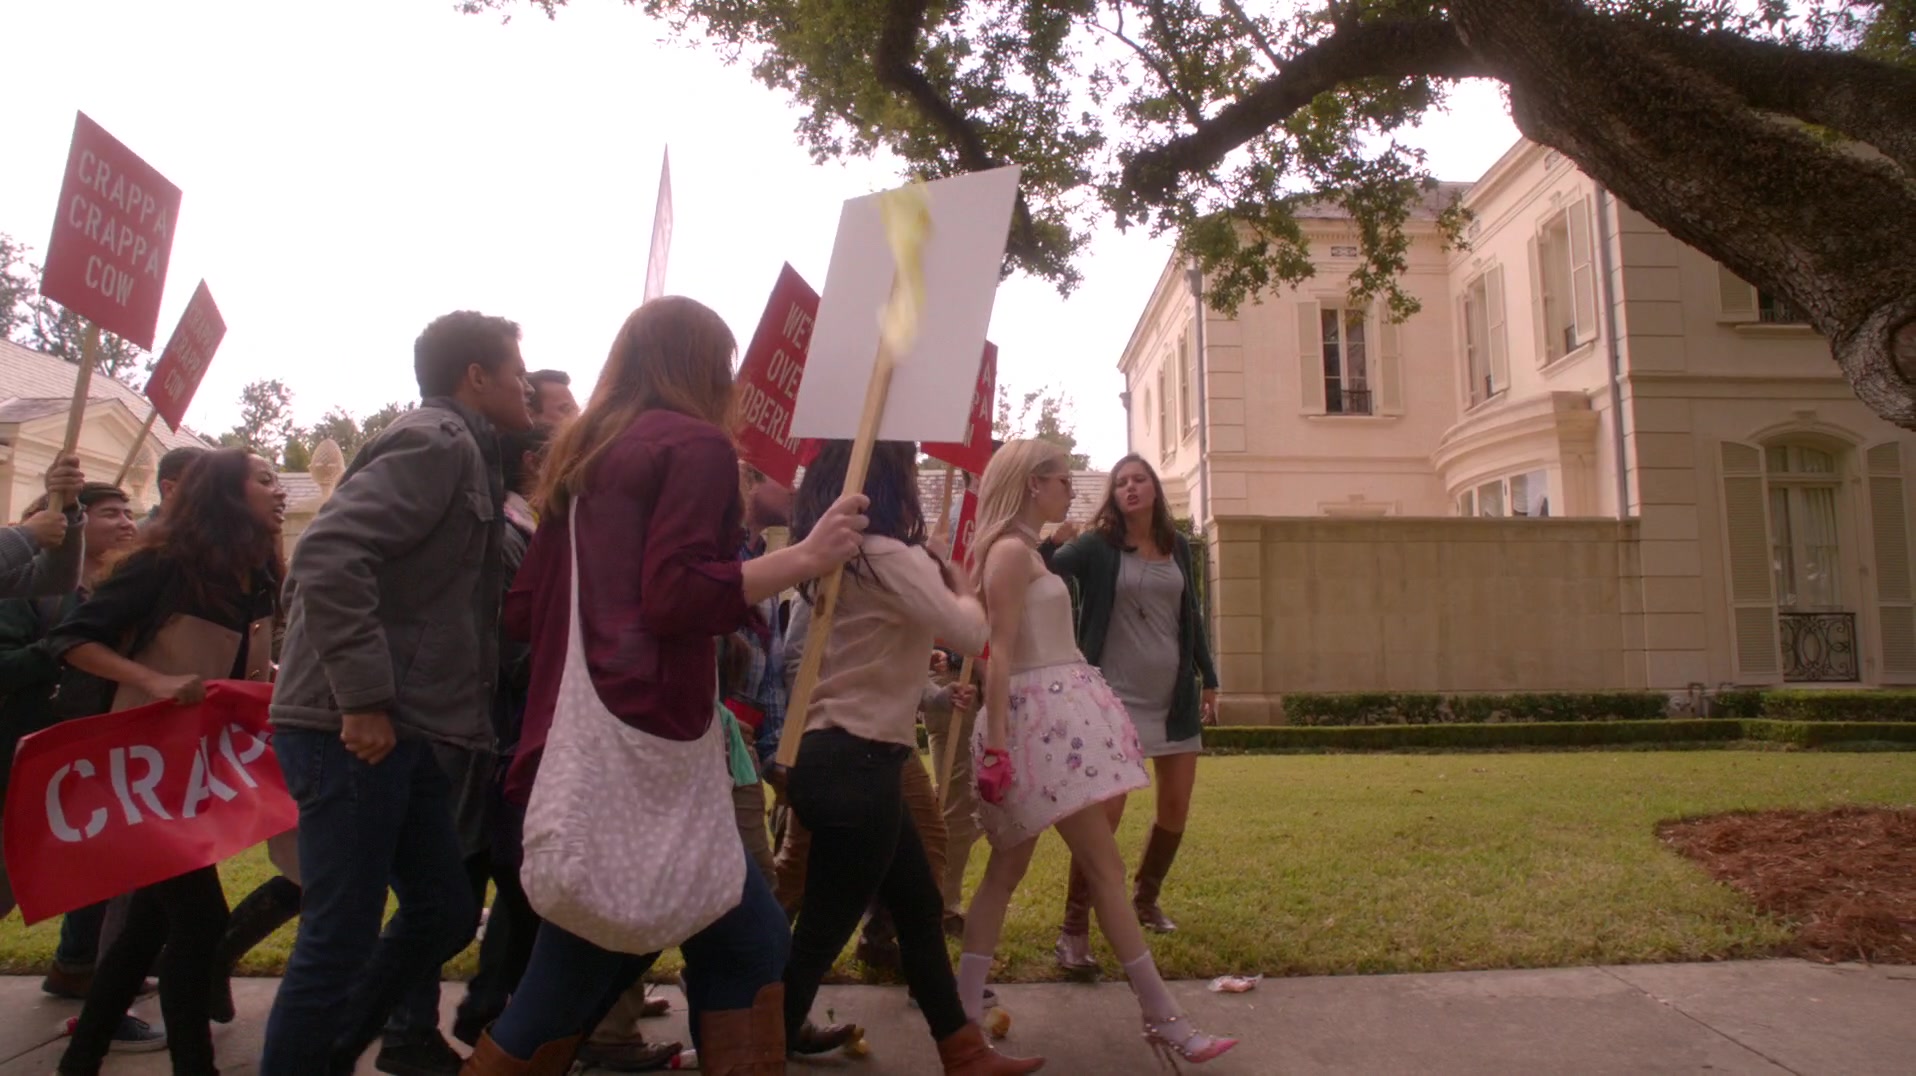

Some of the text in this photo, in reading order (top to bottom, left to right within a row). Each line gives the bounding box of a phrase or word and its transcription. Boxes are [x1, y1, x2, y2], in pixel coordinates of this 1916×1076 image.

[79, 150, 167, 238] CRAPPA
[69, 194, 160, 279] CRAPPA
[85, 255, 134, 307] COW
[783, 301, 816, 354] WE'
[767, 349, 803, 400] OVE
[45, 722, 270, 843] CRAP
